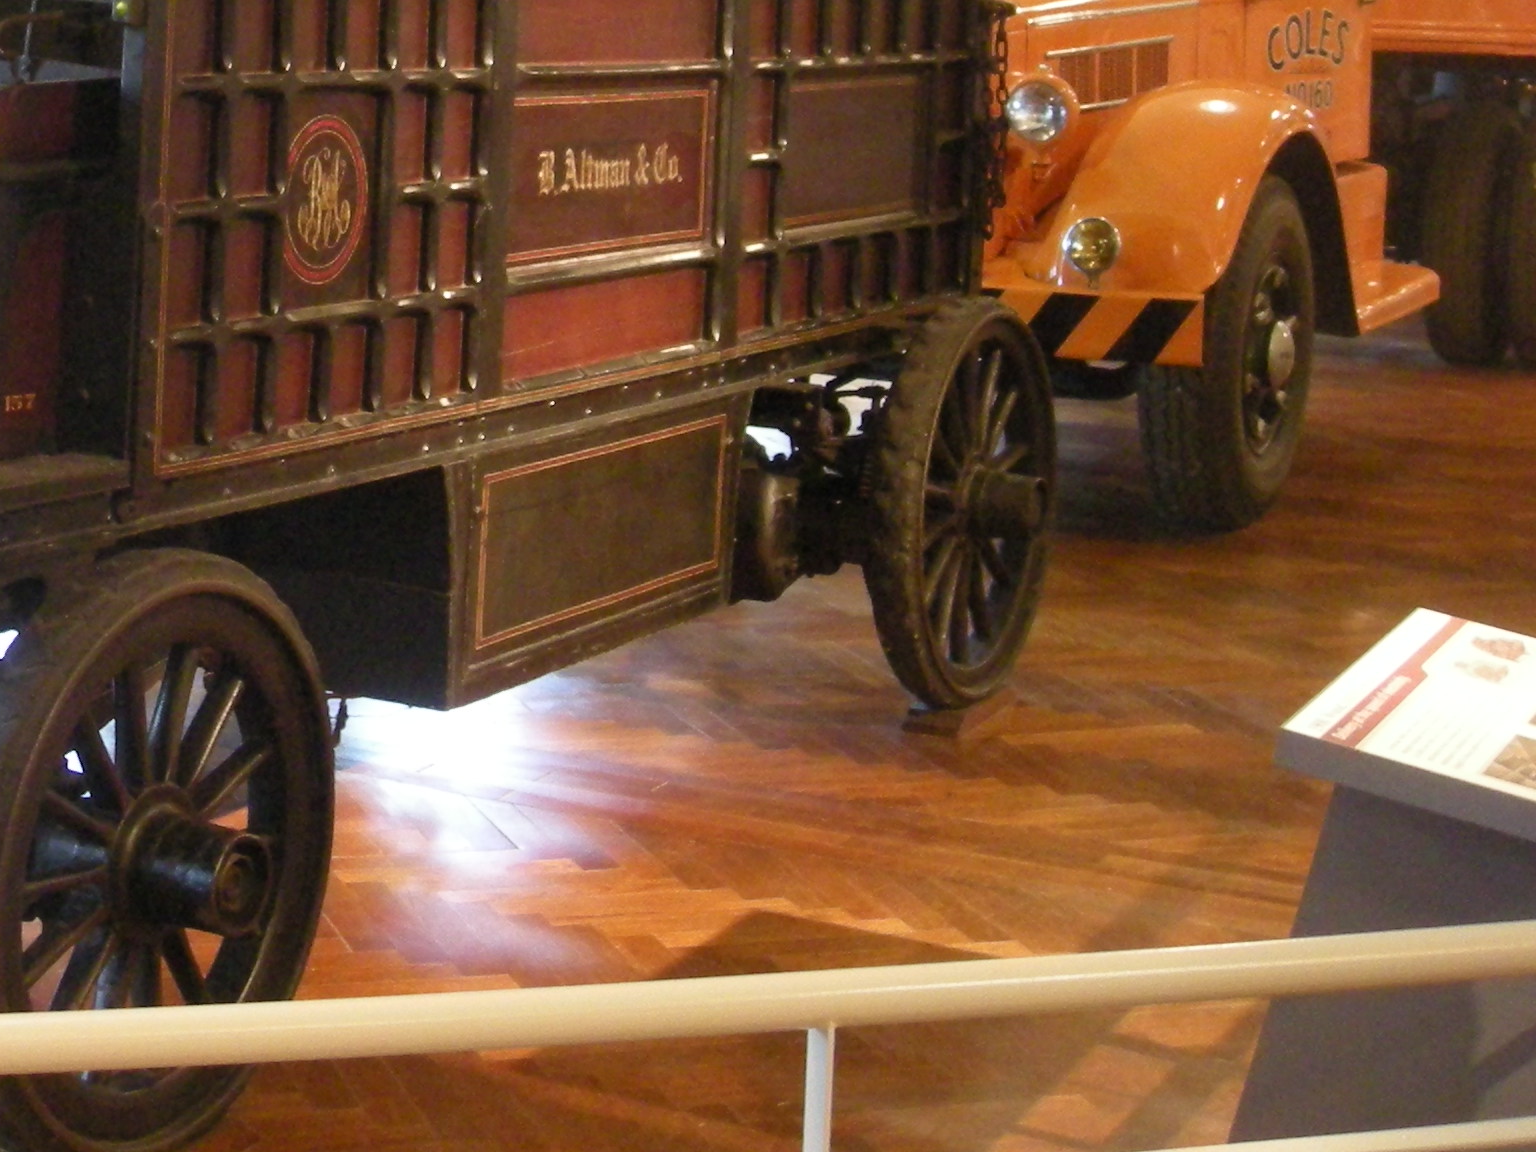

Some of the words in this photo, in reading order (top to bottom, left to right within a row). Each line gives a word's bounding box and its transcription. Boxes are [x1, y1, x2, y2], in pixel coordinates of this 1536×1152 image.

[1268, 8, 1350, 71] COLES
[634, 143, 651, 186] &
[654, 142, 683, 184] Co.
